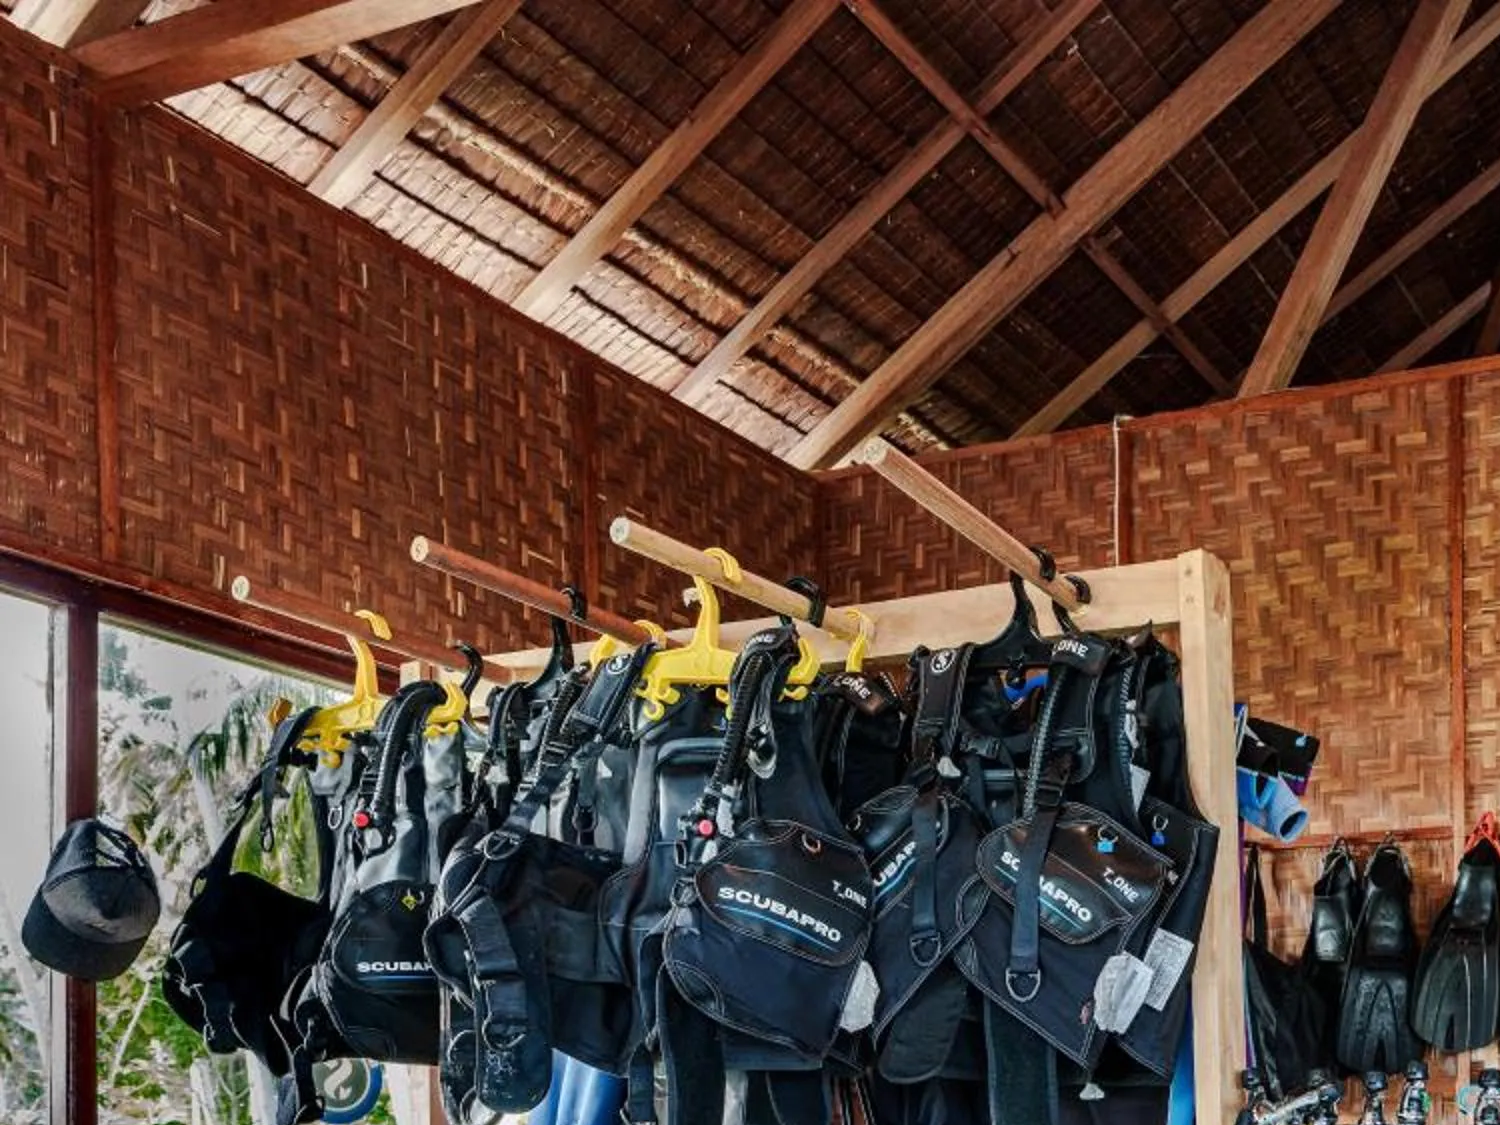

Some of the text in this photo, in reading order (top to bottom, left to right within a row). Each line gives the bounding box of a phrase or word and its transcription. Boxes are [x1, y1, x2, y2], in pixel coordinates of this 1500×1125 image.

[872, 840, 917, 888] UBAP
[1000, 850, 1092, 922] SCAPRO
[717, 886, 842, 942] SCUBAPRO
[357, 961, 433, 973] SCUBA
